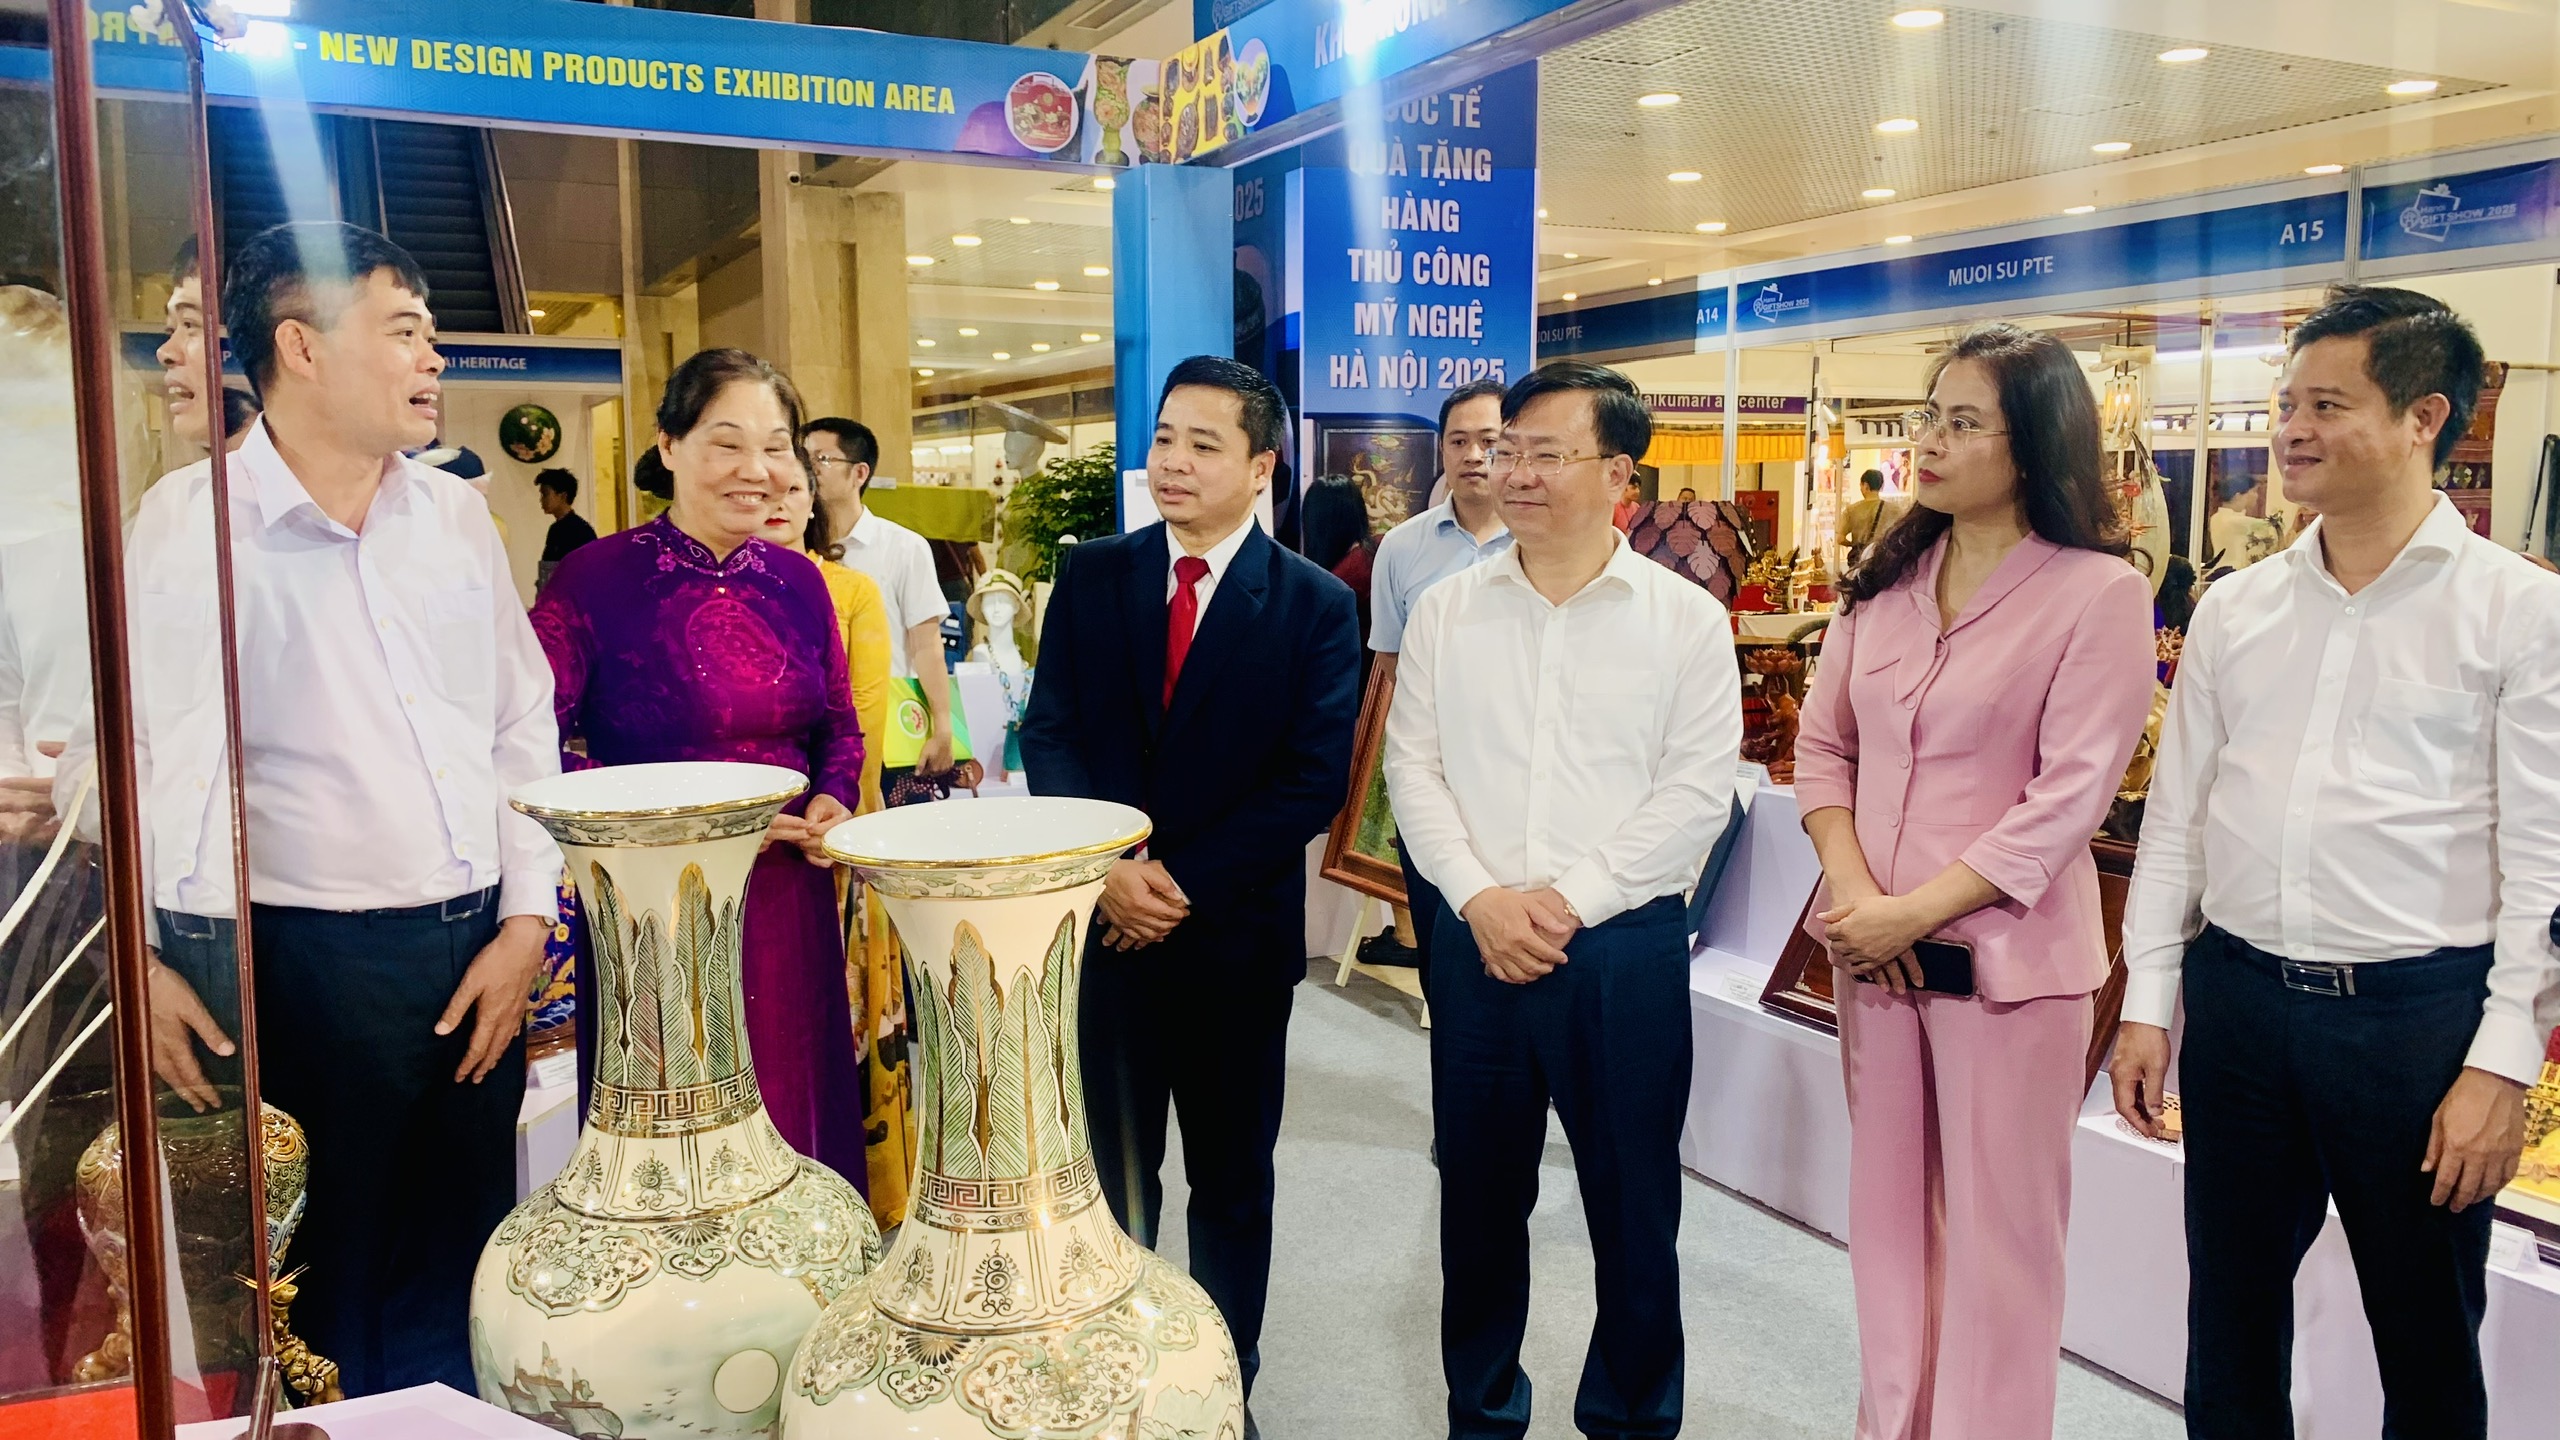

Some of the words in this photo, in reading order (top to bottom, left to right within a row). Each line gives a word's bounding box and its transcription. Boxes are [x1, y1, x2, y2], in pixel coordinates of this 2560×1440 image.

[319, 30, 398, 67] NEW
[411, 39, 532, 79] DESIGN
[543, 51, 705, 94] PRODUCTS
[714, 66, 875, 108] EXHIBITION
[884, 82, 956, 115] AREA
[1449, 84, 1485, 128] TẾ
[1417, 138, 1492, 187] TẶNG
[1234, 176, 1265, 223] 025
[1381, 189, 1460, 233] HÀNG
[2487, 203, 2518, 217] 2025
[2280, 219, 2325, 246] A15
[1347, 238, 1403, 284] THỦ
[1412, 245, 1491, 287] CÔNG
[1948, 263, 1992, 287] MUOI
[1996, 260, 2018, 280] SU
[2022, 255, 2054, 276] PTE
[1353, 296, 1398, 336] MỸ
[1408, 299, 1483, 346] NGHỆ
[1552, 327, 1564, 341] SU
[1566, 325, 1583, 340] PTE
[1696, 306, 1719, 325] A14
[459, 356, 527, 370] HERITAGE
[1329, 348, 1369, 389] HÀ
[1378, 349, 1428, 397] NỘI
[1437, 357, 1505, 389] 2025
[1643, 394, 1711, 409] alkumari
[1739, 396, 1787, 410] center
